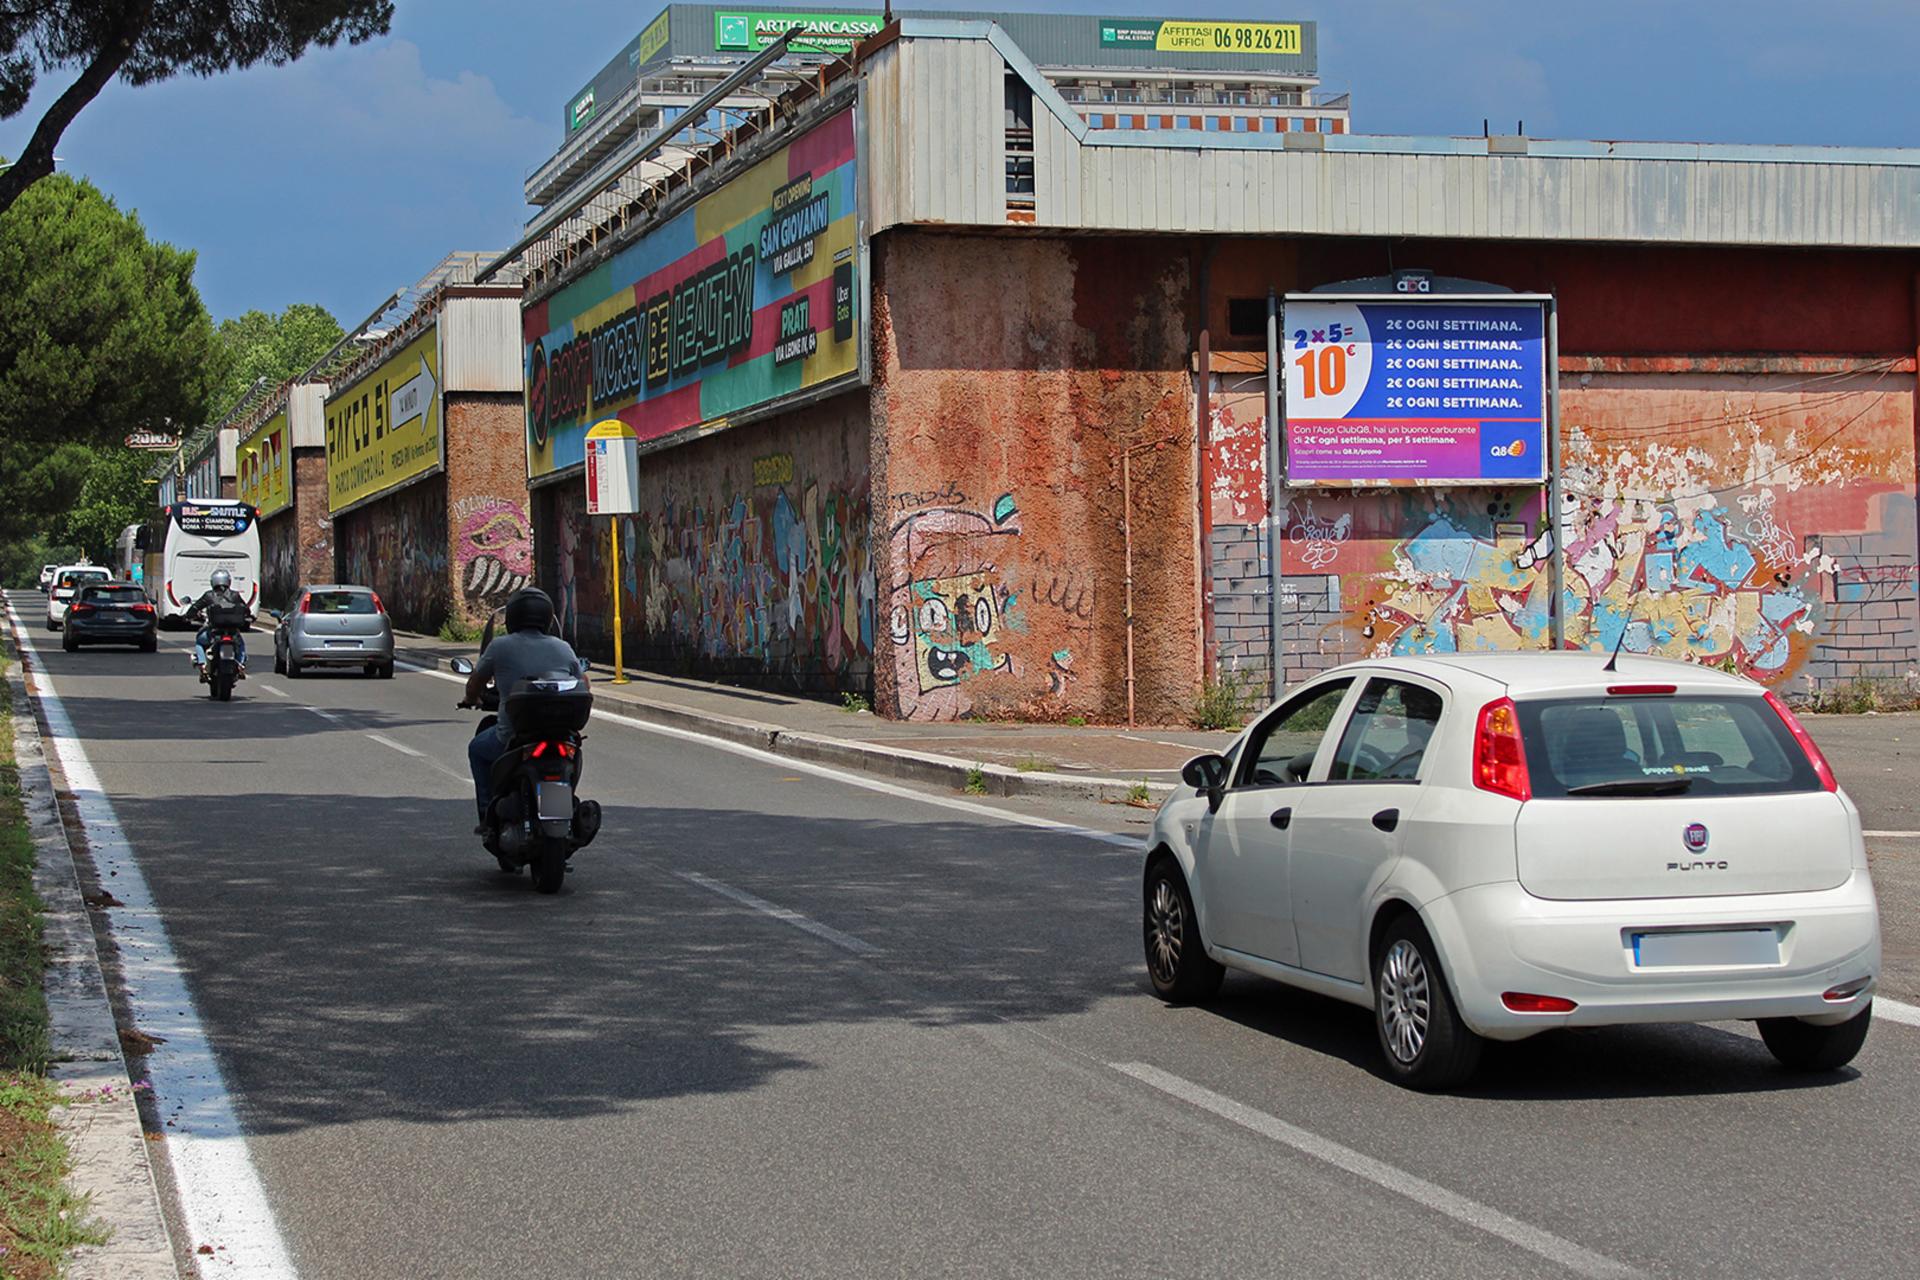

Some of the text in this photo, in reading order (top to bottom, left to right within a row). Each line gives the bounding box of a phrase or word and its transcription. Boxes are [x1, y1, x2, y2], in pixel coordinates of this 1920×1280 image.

[755, 19, 879, 34] ARTIGIANCASSA
[1162, 26, 1213, 37] AFFITTASI
[1170, 37, 1205, 47] UFFICI
[1214, 28, 1296, 50] 06 98 26 211
[760, 196, 828, 258] SAN GIOVANNI
[773, 256, 784, 274] VIA
[784, 247, 802, 271] GALLIA,
[836, 285, 850, 304] Uber
[782, 300, 808, 339] PRATI
[837, 304, 850, 323] Eats
[591, 312, 646, 402] WORRY
[647, 301, 670, 380] BE
[673, 255, 753, 370] HEALTHY!
[1386, 319, 1523, 332] 2€ OGNI SETTIMANA.
[775, 345, 785, 363] VIA
[785, 339, 802, 360] LEONE
[1386, 339, 1523, 351] 2€ OGNI SETTIMANA.
[1386, 358, 1523, 370] 2€ OGNI SETTIMANA.
[1386, 377, 1523, 390] 2€ OGNI SETTIMANA.
[1386, 396, 1523, 409] 2€ OGNI SETTIMANA.
[1293, 425, 1311, 435] Con
[1373, 425, 1386, 434] hai
[1401, 425, 1429, 434] buono
[1430, 425, 1477, 434] carburante
[1293, 436, 1302, 445] di
[1318, 436, 1339, 446] ogni
[1340, 436, 1386, 446] settimana,
[1387, 438, 1403, 446] per
[1405, 436, 1411, 444] 5
[1412, 436, 1457, 445] settimane.
[1294, 448, 1315, 456] Scopri
[1490, 445, 1508, 458] Q8
[181, 506, 200, 516] BUS
[210, 506, 247, 517] SHUTTLE
[204, 517, 236, 525] CIAMPINO
[1689, 830, 1705, 843] FIAT
[1666, 860, 1729, 872] PUNTO
